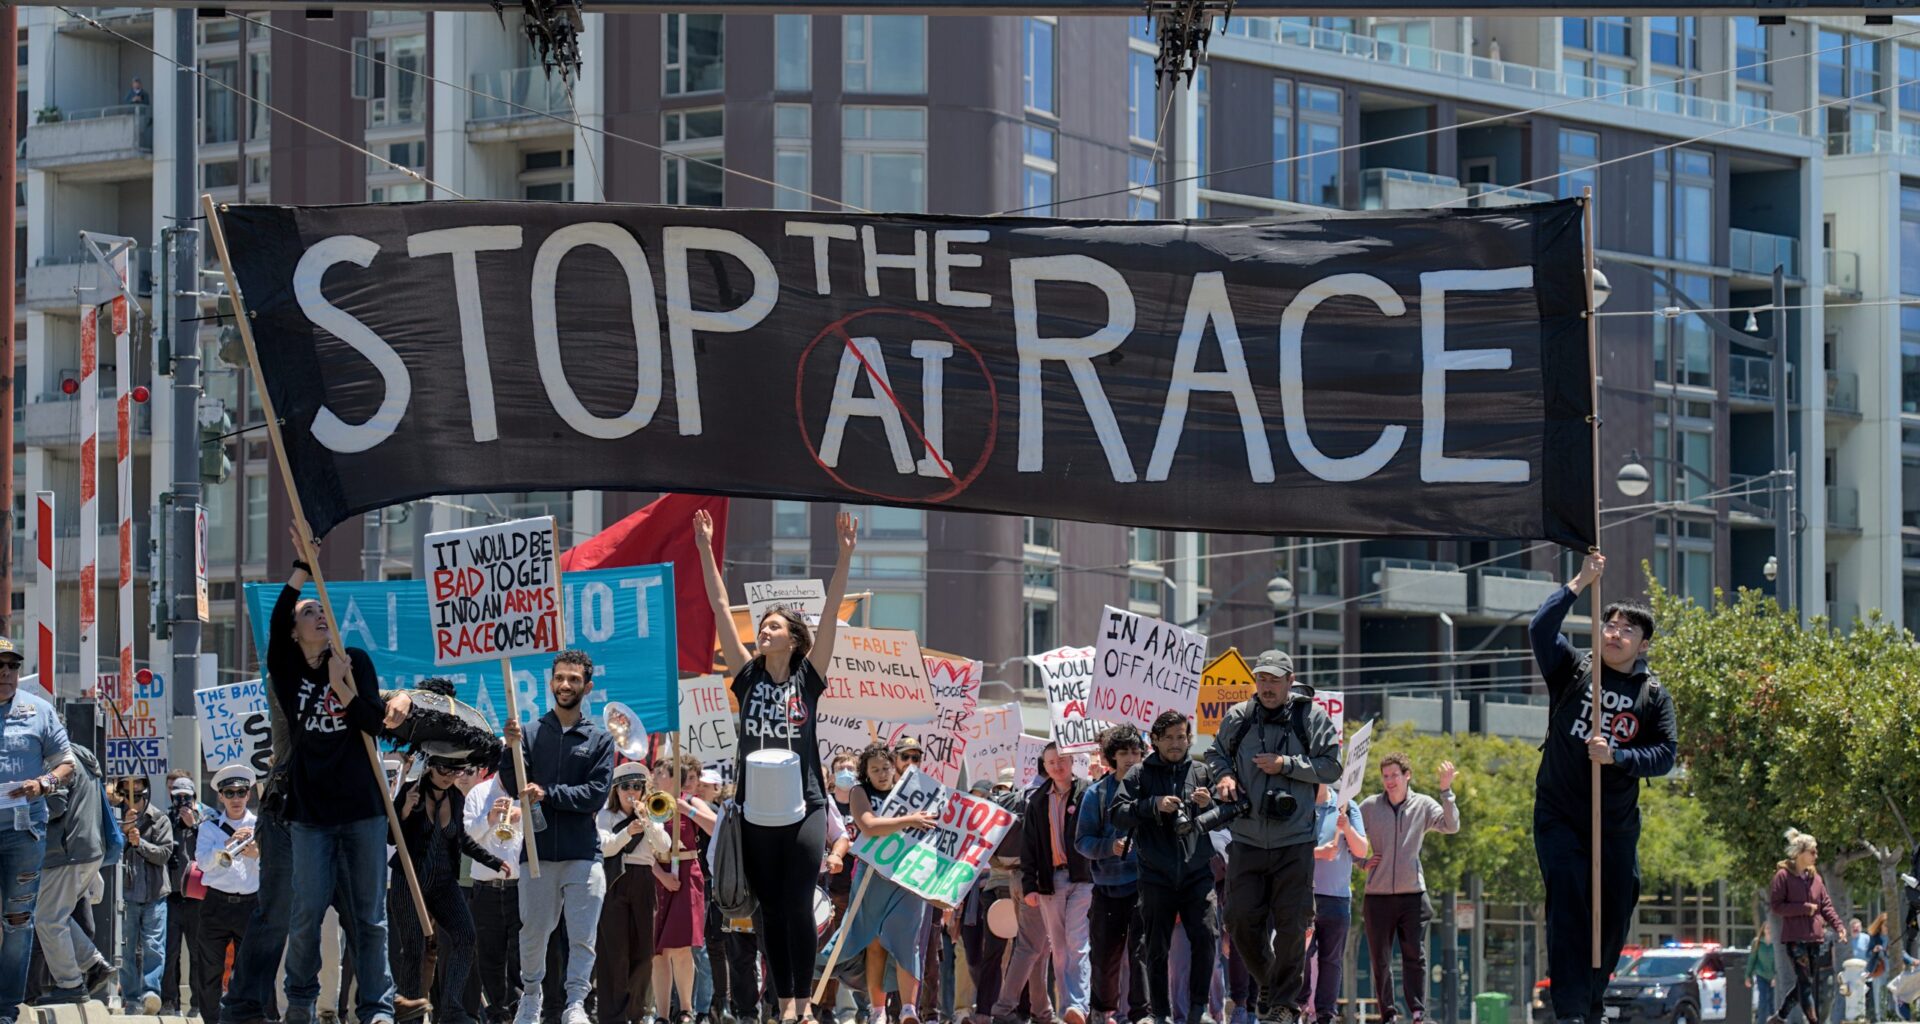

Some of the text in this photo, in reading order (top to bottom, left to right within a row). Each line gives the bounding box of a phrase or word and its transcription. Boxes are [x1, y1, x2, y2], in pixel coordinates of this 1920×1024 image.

[293, 222, 1535, 483] STOP THE AI RACE
[432, 530, 552, 570] IT WOULD BE
[433, 557, 553, 601] BAD TO GET
[751, 585, 764, 601] AI
[339, 592, 398, 651] AI
[435, 587, 555, 628] INTO AN ARMS
[437, 611, 559, 660] RACE OVER AI
[1107, 613, 1204, 675] IN A RACE
[846, 657, 876, 678] END
[878, 661, 920, 678] WELL
[1104, 649, 1198, 700] OFF A CLIFF
[197, 687, 226, 705] THE
[687, 687, 725, 715] THE
[859, 680, 878, 697] AI
[880, 682, 926, 703] NOW!
[1048, 681, 1087, 703] MAKE
[1095, 685, 1117, 711] NO
[1120, 693, 1154, 723] ONE
[1217, 688, 1249, 700] Scott
[748, 699, 786, 721] THE
[1580, 700, 1614, 731] TE
[107, 718, 157, 738] IGHTS
[211, 721, 241, 741] LIG
[745, 718, 802, 739] RACE
[896, 770, 946, 820] Let's
[942, 792, 1013, 836] STOP
[955, 833, 994, 867] AI
